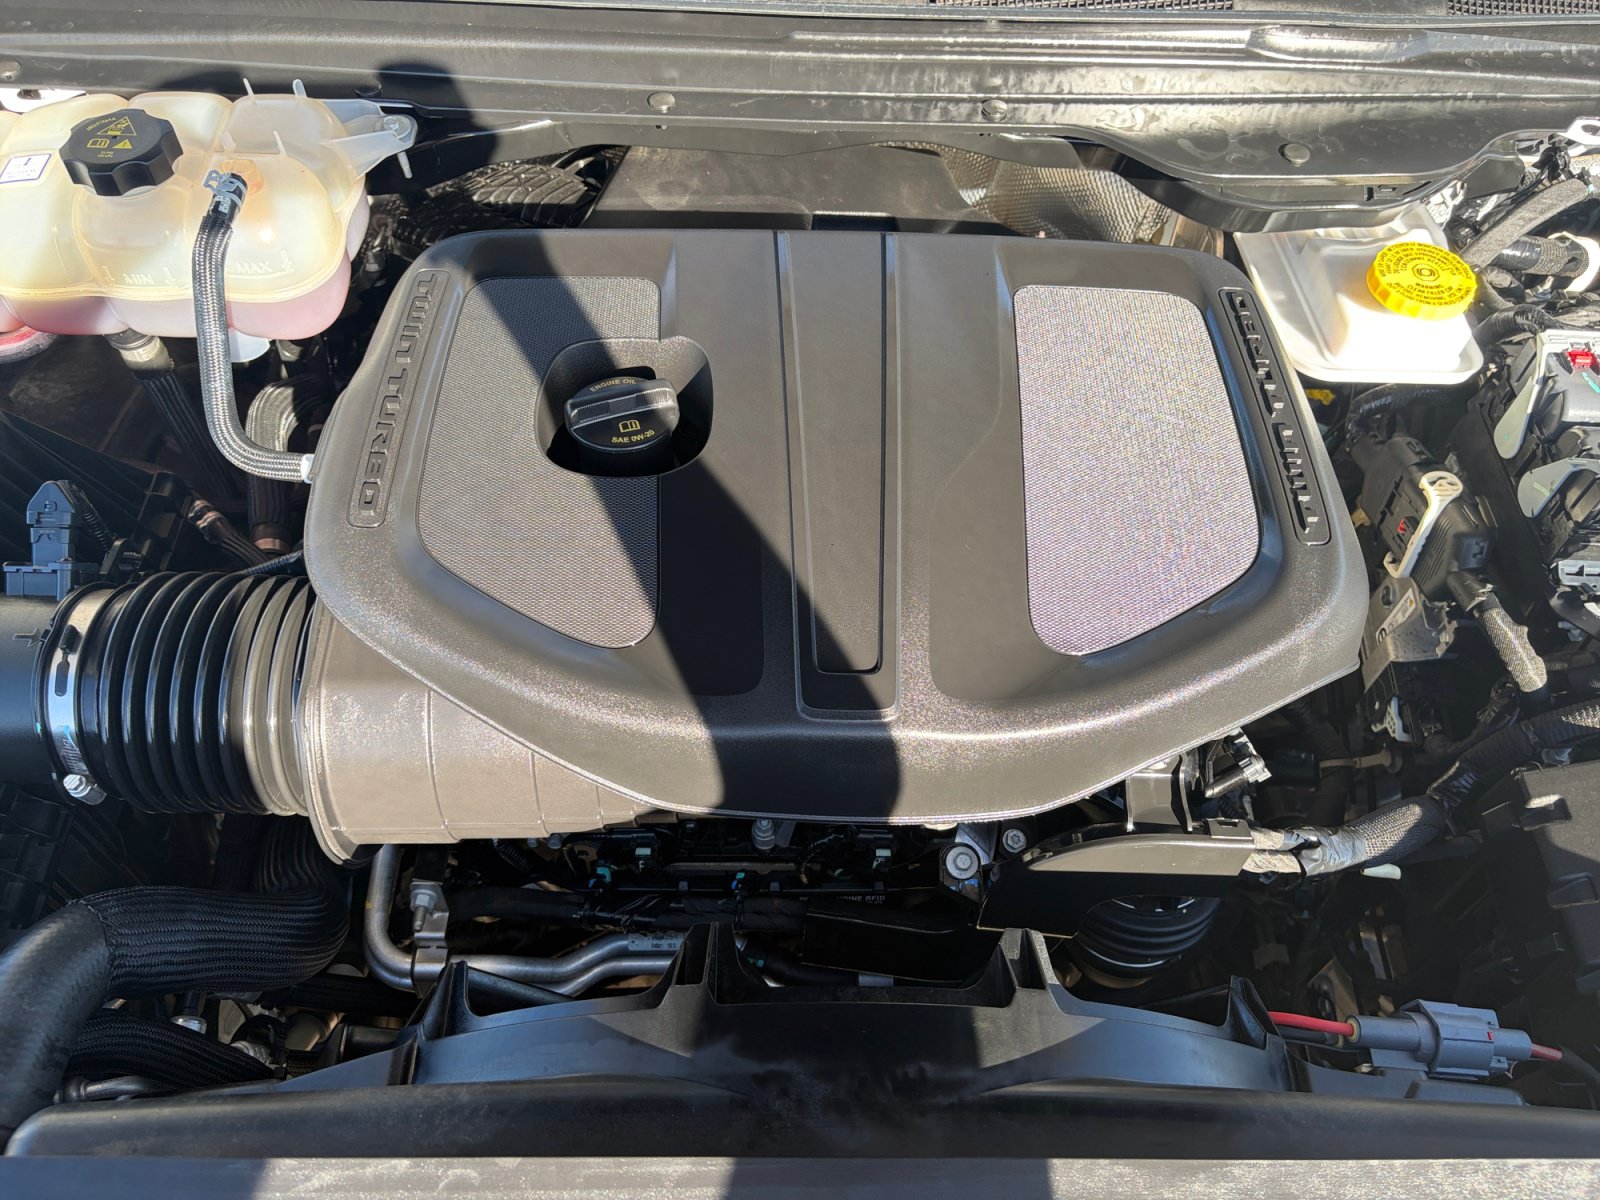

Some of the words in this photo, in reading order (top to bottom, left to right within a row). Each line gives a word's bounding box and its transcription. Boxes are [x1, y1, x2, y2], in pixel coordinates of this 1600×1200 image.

[237, 262, 272, 274] MAX
[123, 273, 154, 285] MIN
[394, 272, 438, 364] TWIN
[590, 379, 620, 393] ENGINE
[357, 367, 408, 517] TURBO
[611, 436, 630, 444] SAE
[631, 429, 656, 443] 0W-20
